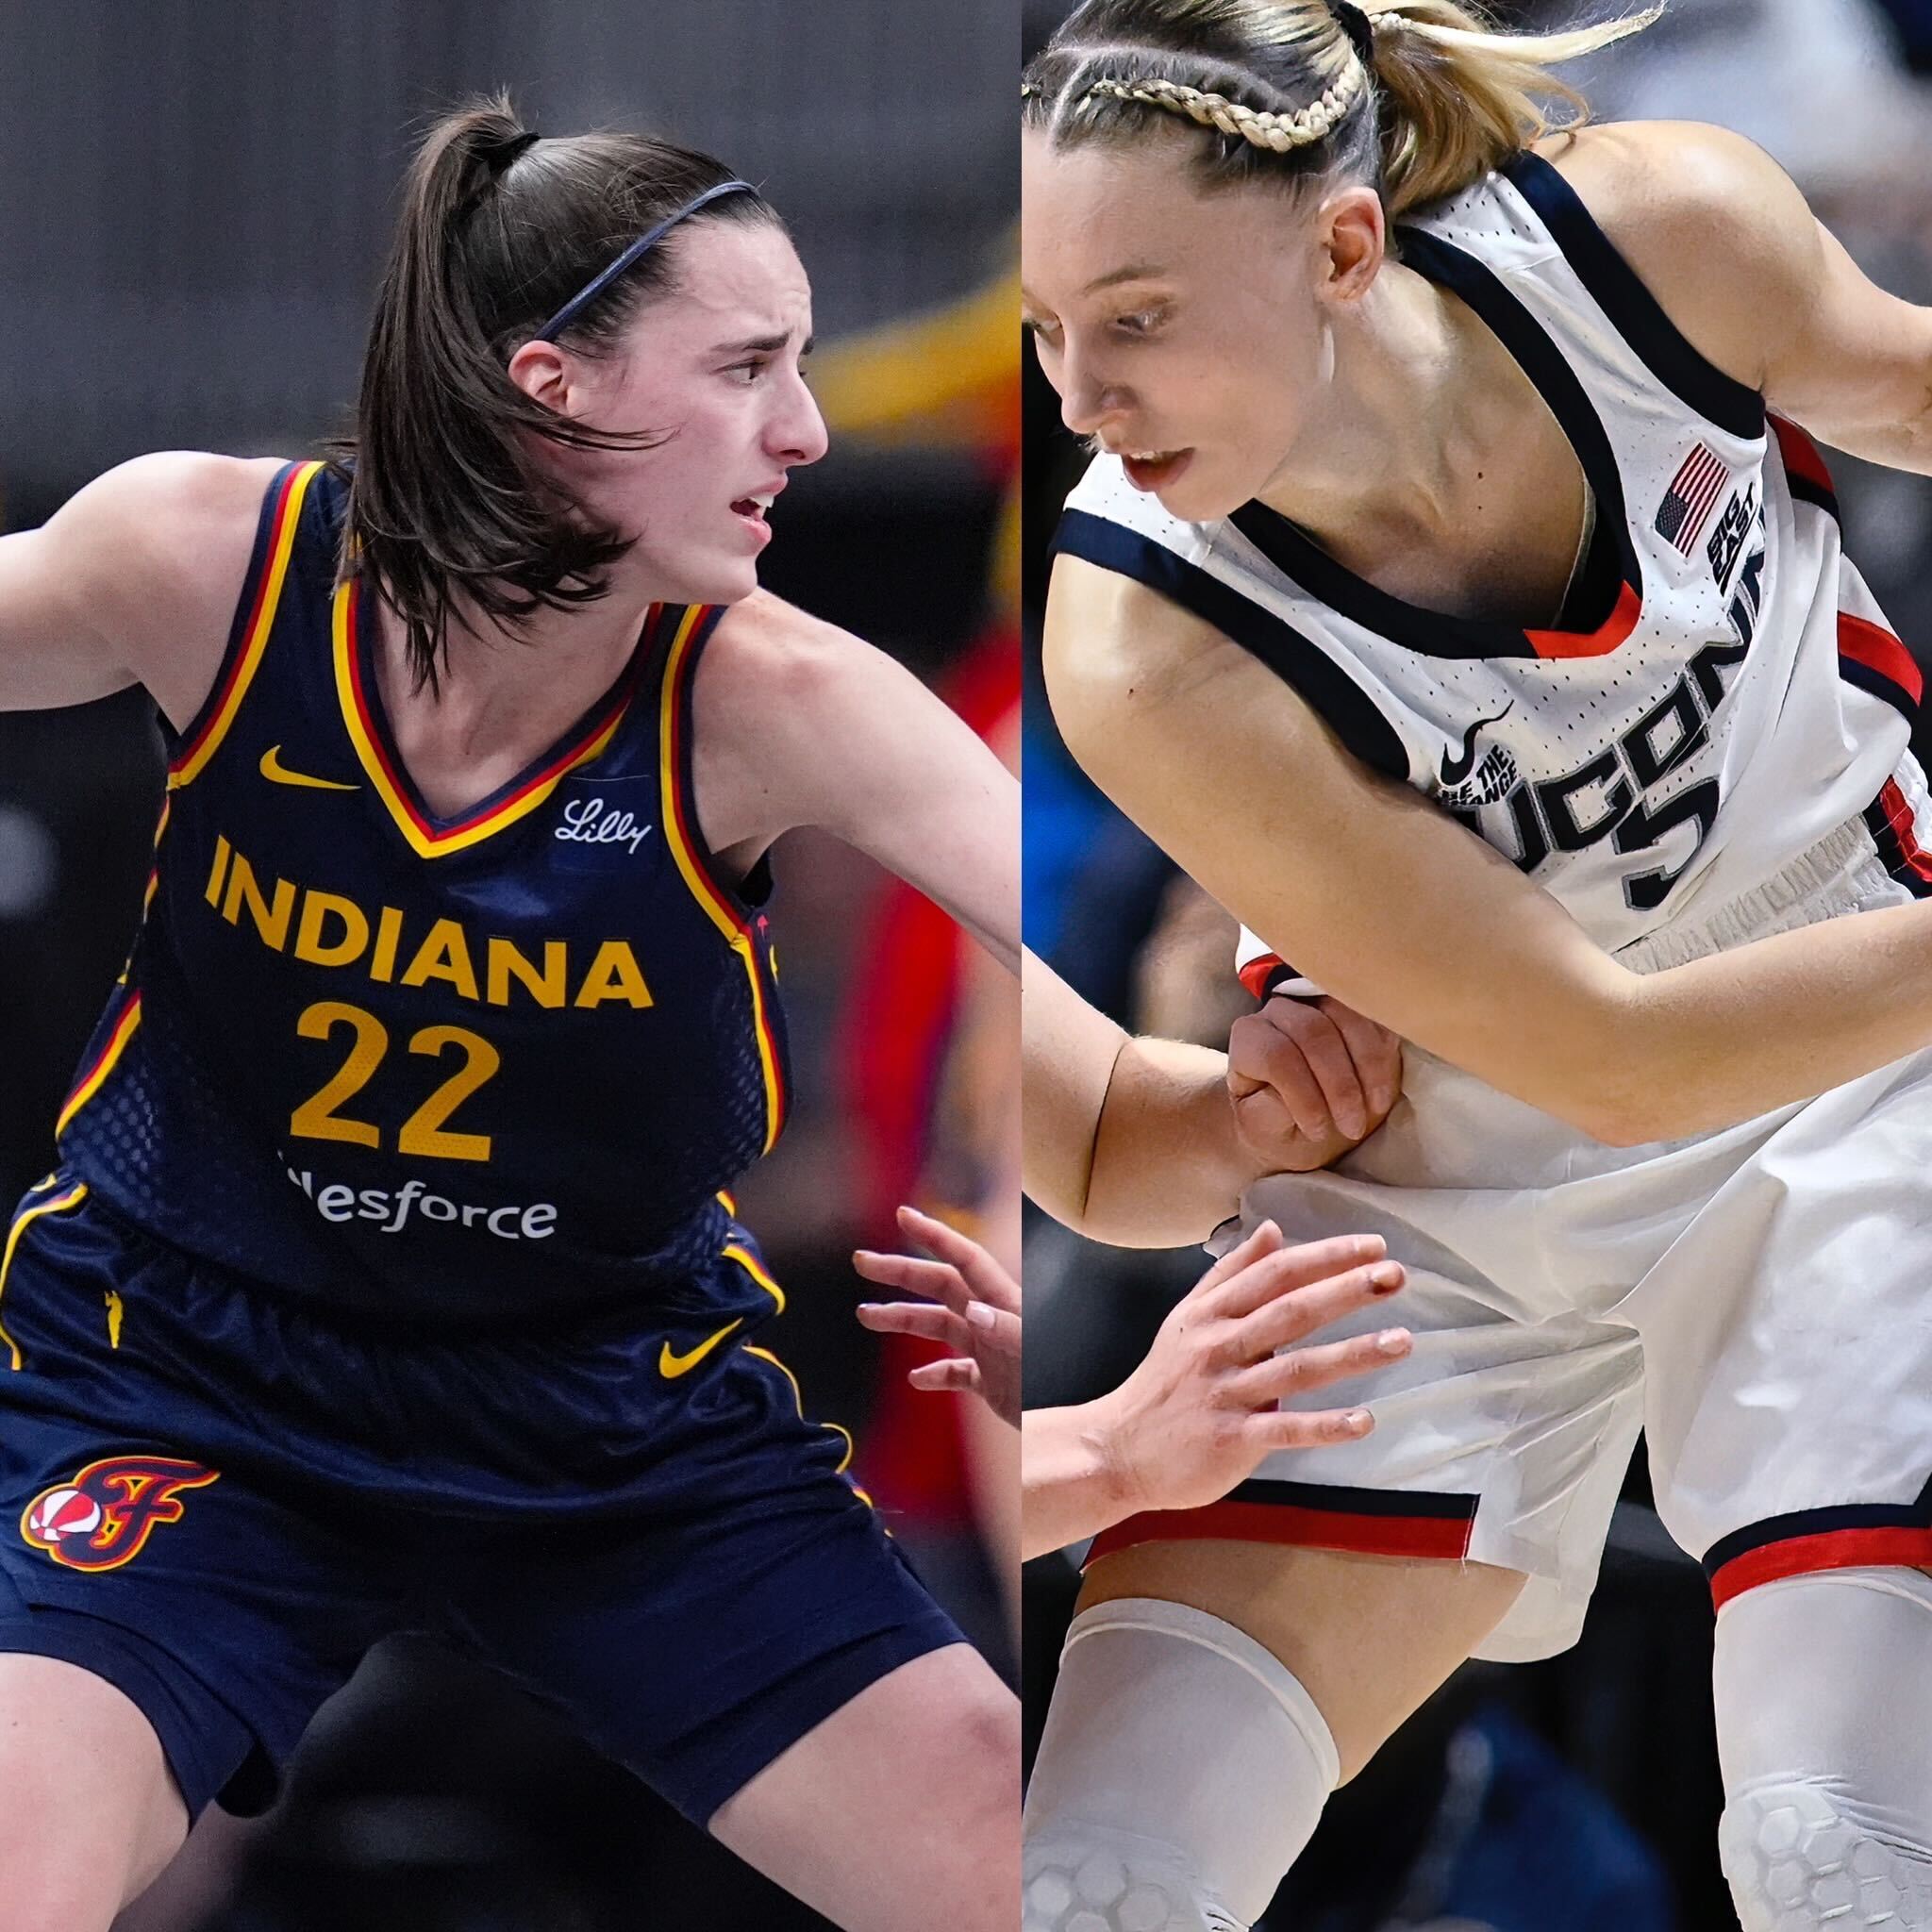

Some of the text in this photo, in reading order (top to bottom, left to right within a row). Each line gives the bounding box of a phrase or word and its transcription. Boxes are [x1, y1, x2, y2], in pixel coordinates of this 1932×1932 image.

[1707, 489, 1740, 565] BIG
[1712, 481, 1754, 586] EAST
[1476, 743, 1509, 791] THE
[555, 797, 653, 855] Lilly
[1609, 774, 1721, 911] 5
[204, 834, 655, 1009] INDIANA
[290, 1001, 501, 1162] 22
